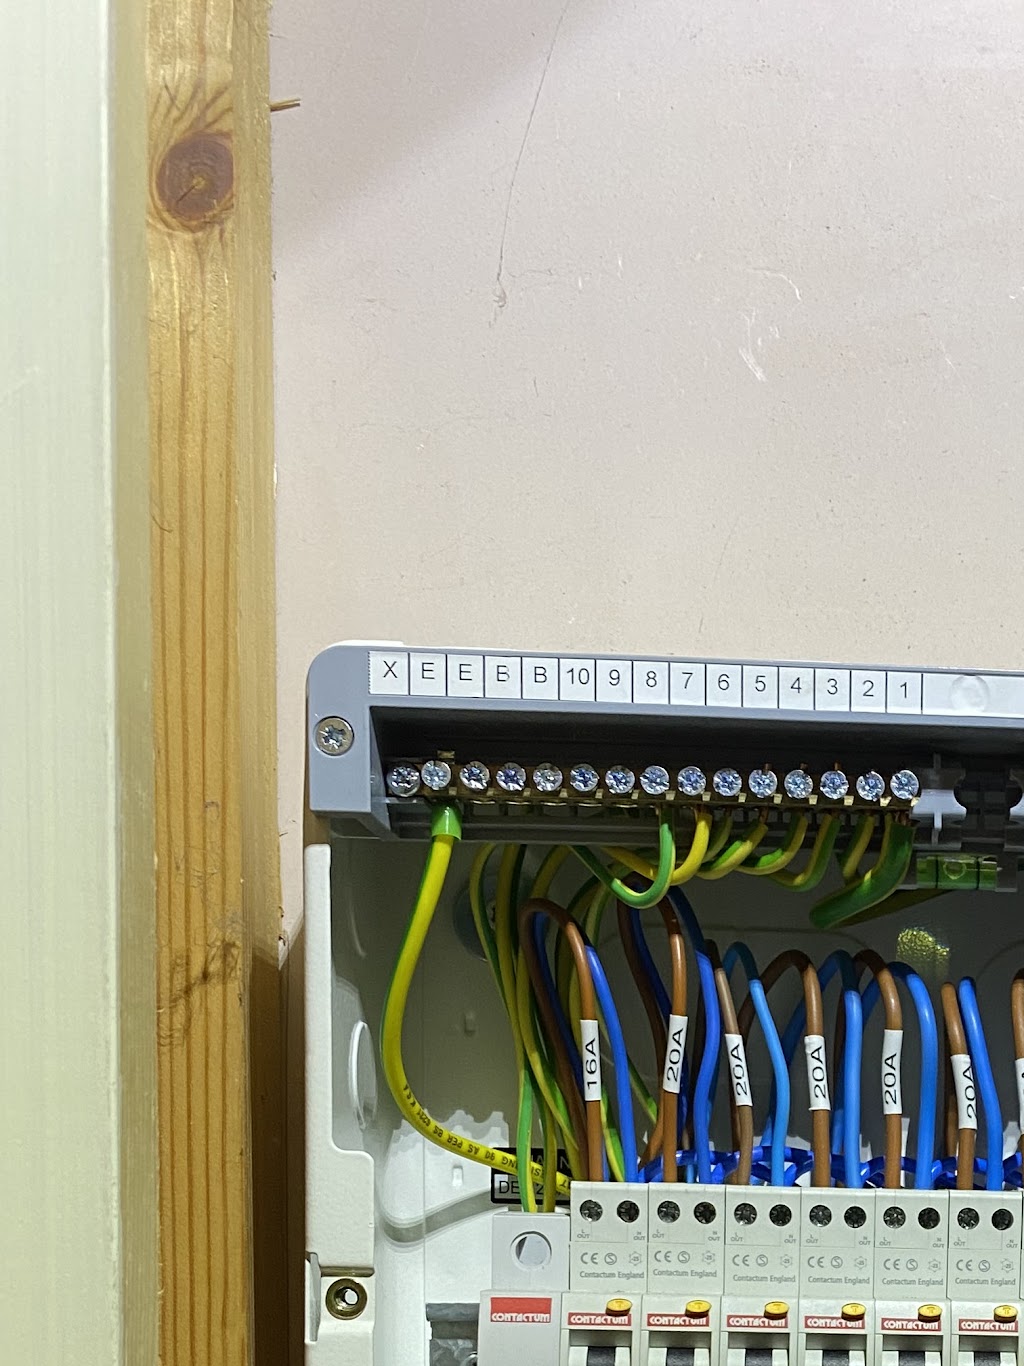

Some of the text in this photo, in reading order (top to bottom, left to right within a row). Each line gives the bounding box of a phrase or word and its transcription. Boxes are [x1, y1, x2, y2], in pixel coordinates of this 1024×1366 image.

[384, 661, 397, 678] X
[422, 663, 434, 679] E
[460, 664, 472, 680] E
[535, 667, 547, 683] B
[567, 668, 589, 684] 10
[609, 670, 620, 686] 9
[646, 671, 657, 687] 8
[682, 672, 693, 689] 7
[718, 674, 729, 690] 6
[755, 676, 765, 691] 5
[791, 677, 801, 693] 4
[827, 679, 837, 695] 3
[863, 680, 873, 697] 2
[901, 682, 906, 698] 1
[666, 1028, 683, 1082] 20A
[586, 1038, 597, 1087] 16A
[730, 1043, 749, 1096] 20A
[811, 1046, 827, 1099] 20A
[884, 1053, 897, 1105] 20A
[965, 1066, 977, 1118] 20A
[447, 1137, 462, 1148] PER
[580, 1271, 645, 1280] Contactum England
[653, 1269, 717, 1279] Contactum England
[733, 1275, 796, 1284] Contactum England
[808, 1276, 870, 1285] Contactum England
[918, 1278, 943, 1287] England
[991, 1278, 1016, 1287] England
[492, 1313, 550, 1322] CONTACTUM
[570, 1316, 628, 1325] CONTACTUM
[730, 1318, 787, 1327] CONTACTUM
[884, 1321, 939, 1330] CONTACTUM
[961, 1322, 1016, 1331] CONTACTUM
